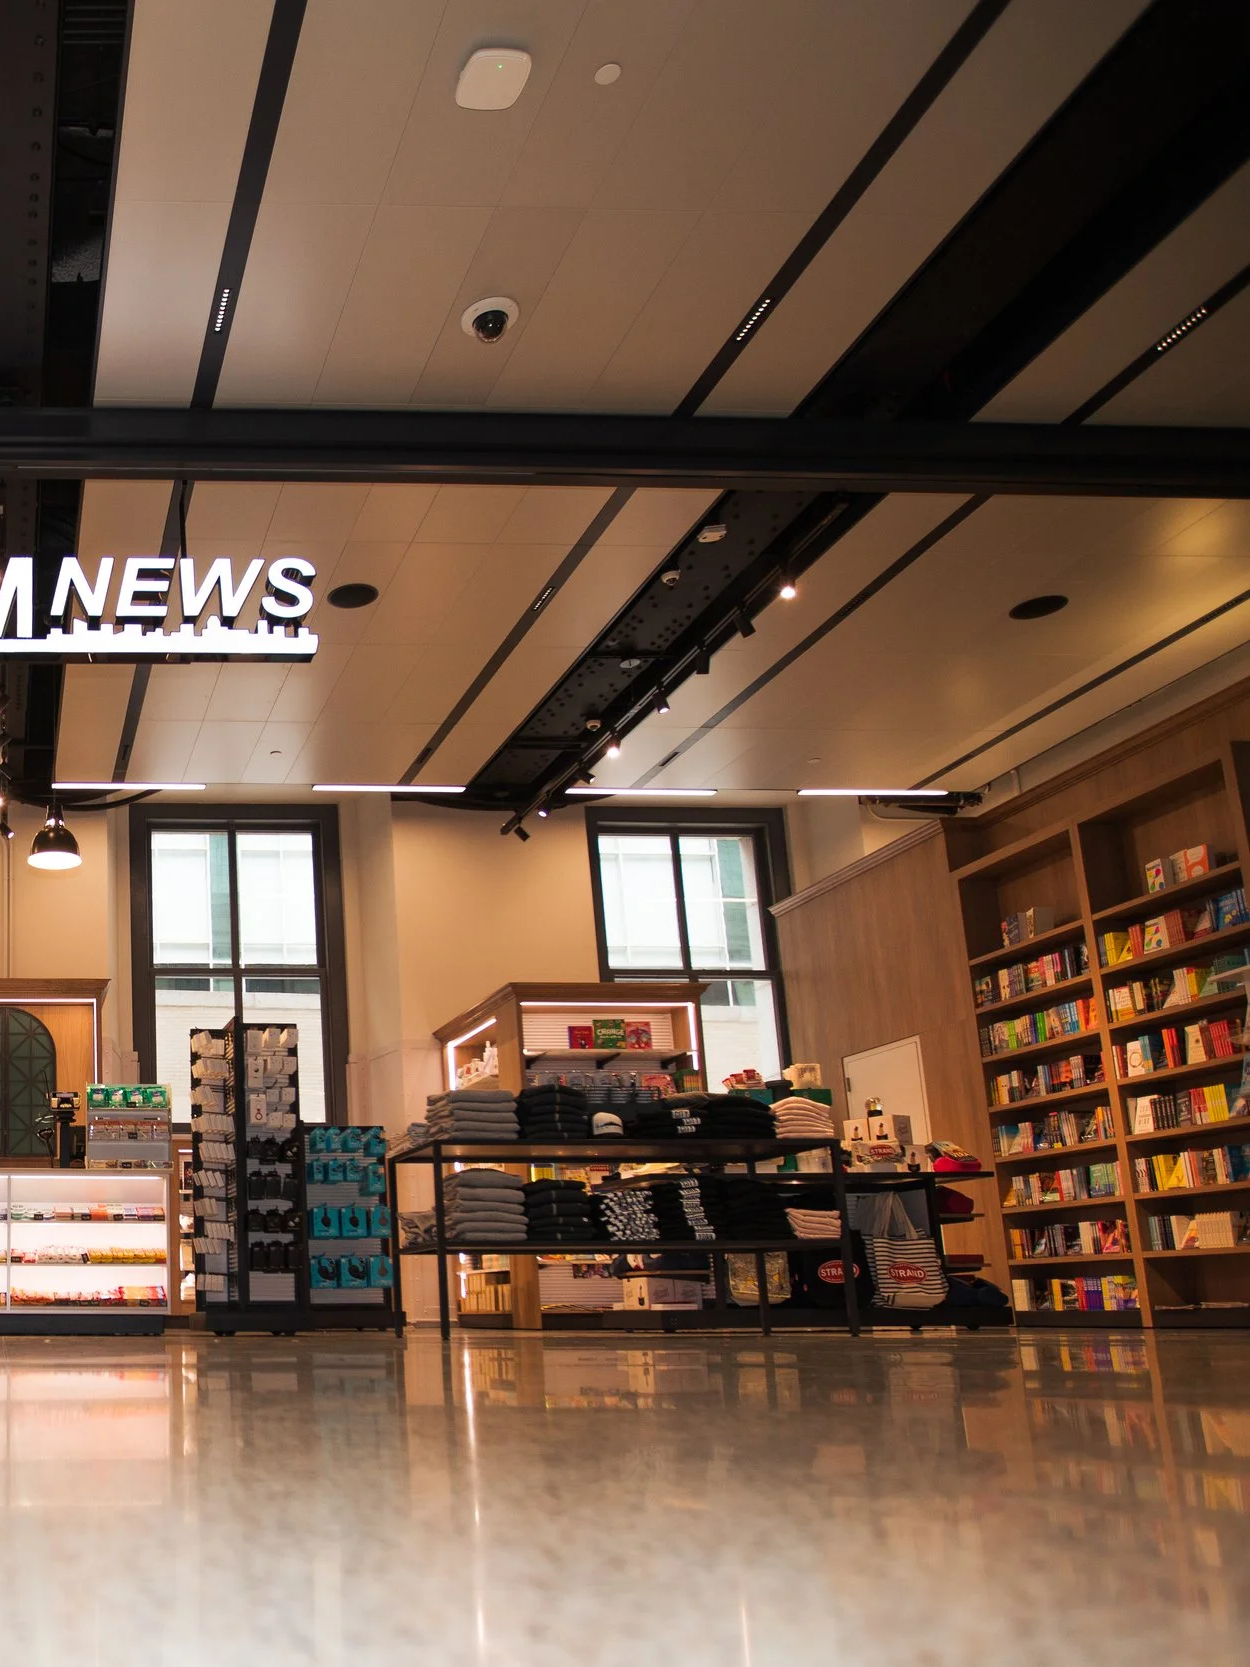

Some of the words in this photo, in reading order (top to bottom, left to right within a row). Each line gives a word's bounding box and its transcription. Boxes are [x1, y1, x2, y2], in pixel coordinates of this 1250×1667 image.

[50, 557, 317, 618] NEWS
[820, 1267, 856, 1277] STRA
[890, 1268, 925, 1278] STRAND
